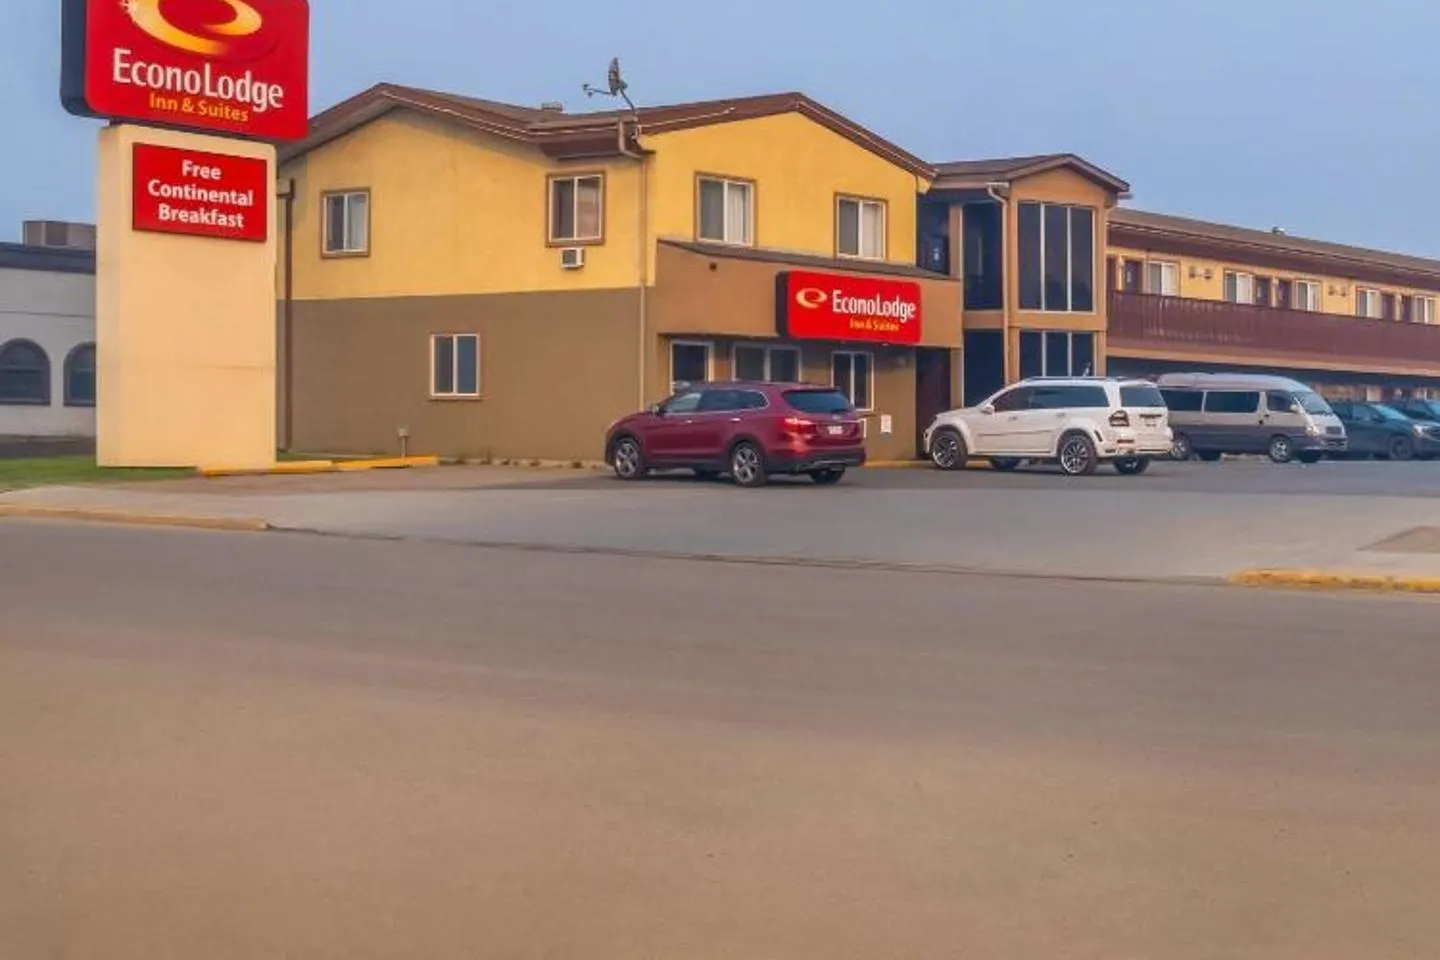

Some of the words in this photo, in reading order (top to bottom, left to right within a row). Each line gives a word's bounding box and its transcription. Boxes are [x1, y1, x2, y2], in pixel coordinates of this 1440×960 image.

[112, 48, 284, 112] EconoLodge
[149, 92, 178, 111] Inn
[181, 97, 196, 113] &
[197, 99, 249, 122] Suites
[181, 159, 222, 180] Free
[147, 178, 254, 206] Continental
[158, 203, 245, 228] Breakfast
[832, 289, 917, 323] EconoLodge
